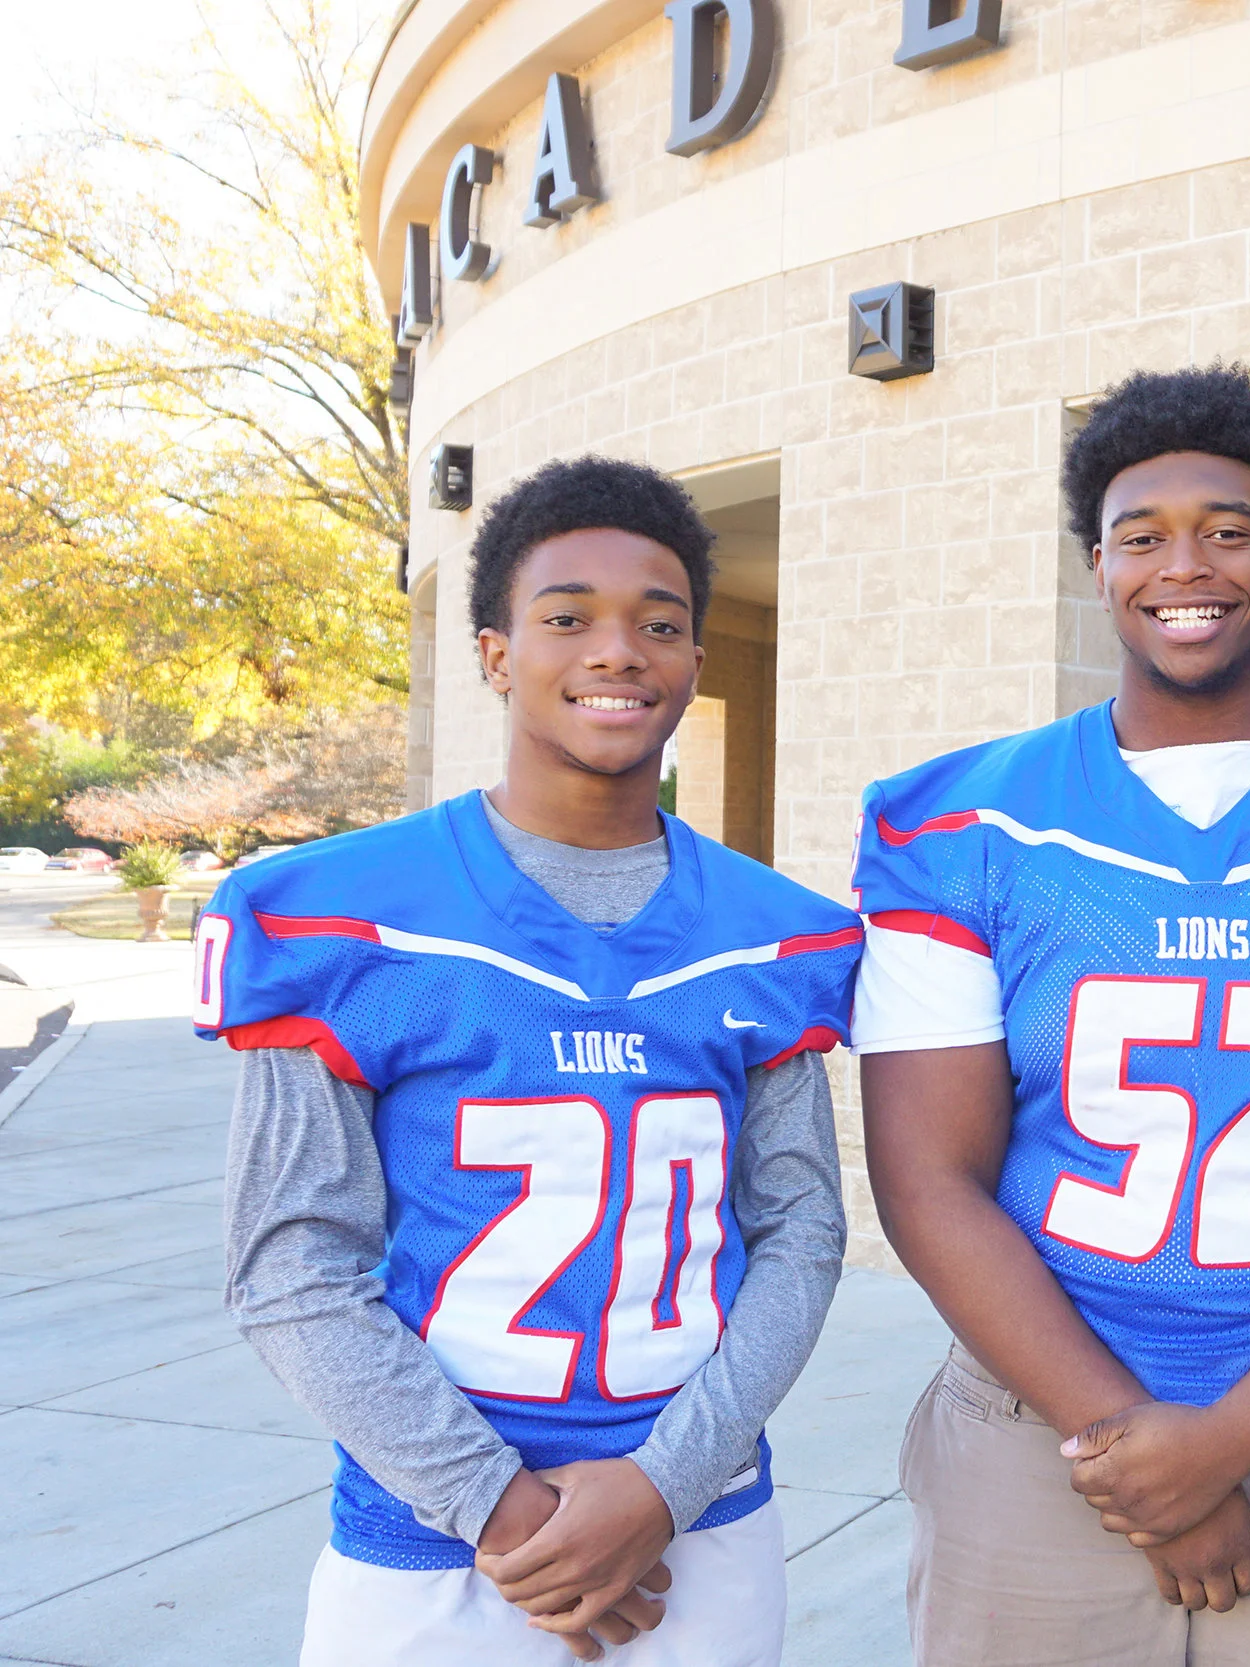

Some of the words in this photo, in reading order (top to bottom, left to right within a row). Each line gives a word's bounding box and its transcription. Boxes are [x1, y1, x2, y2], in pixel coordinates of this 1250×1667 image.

[193, 912, 234, 1030] 0
[1156, 917, 1249, 960] LIONS
[551, 1031, 647, 1074] LIONS
[423, 1092, 726, 1401] 20
